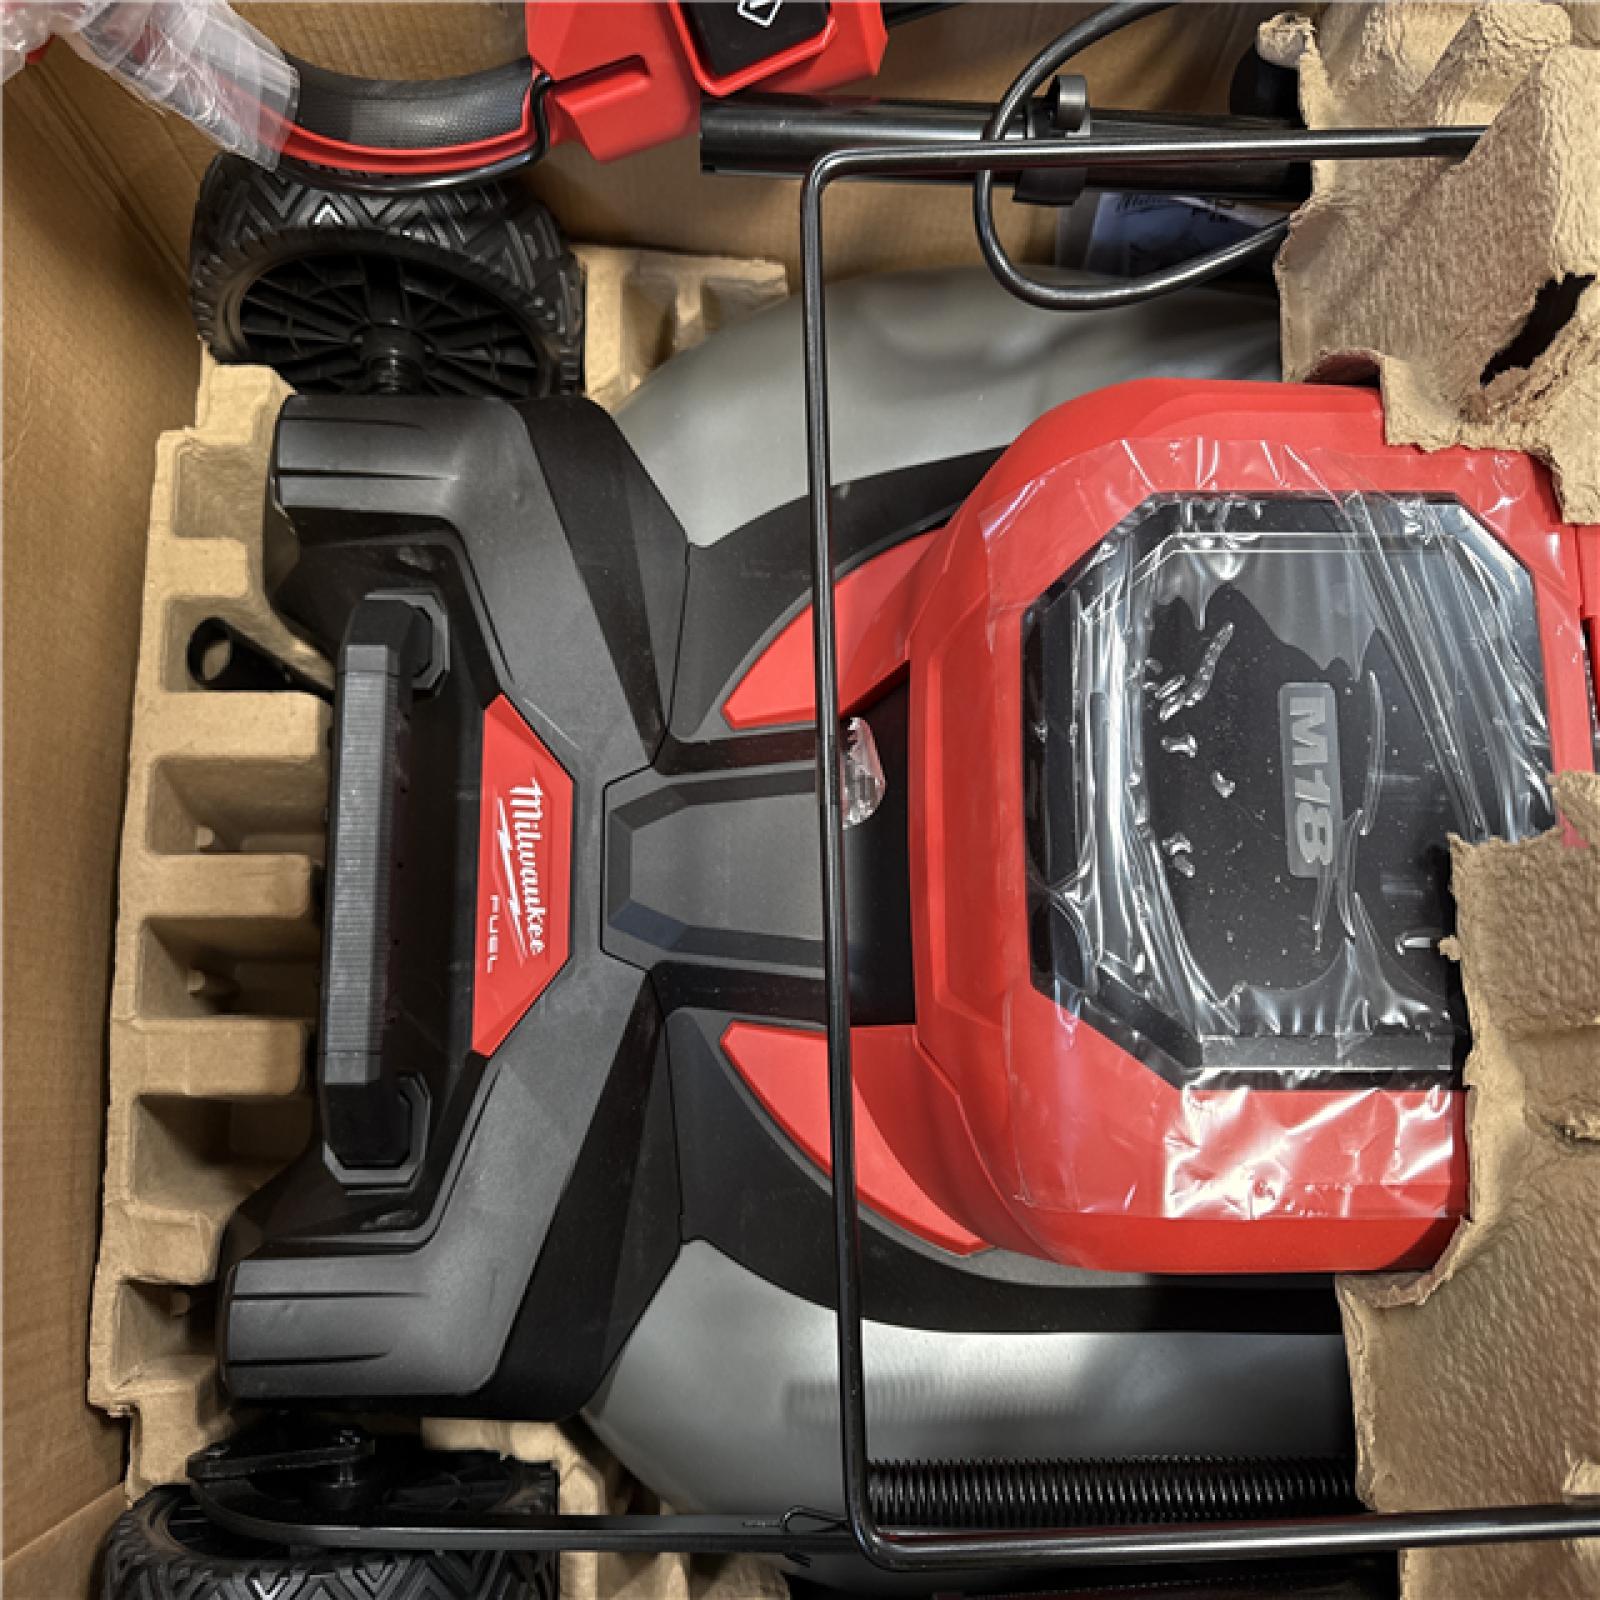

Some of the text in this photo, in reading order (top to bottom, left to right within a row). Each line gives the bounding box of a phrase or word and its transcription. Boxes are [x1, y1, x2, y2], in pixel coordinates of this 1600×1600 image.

[1289, 696, 1334, 866] M18
[487, 894, 501, 974] FUEL
[509, 777, 546, 956] Milwaukee
